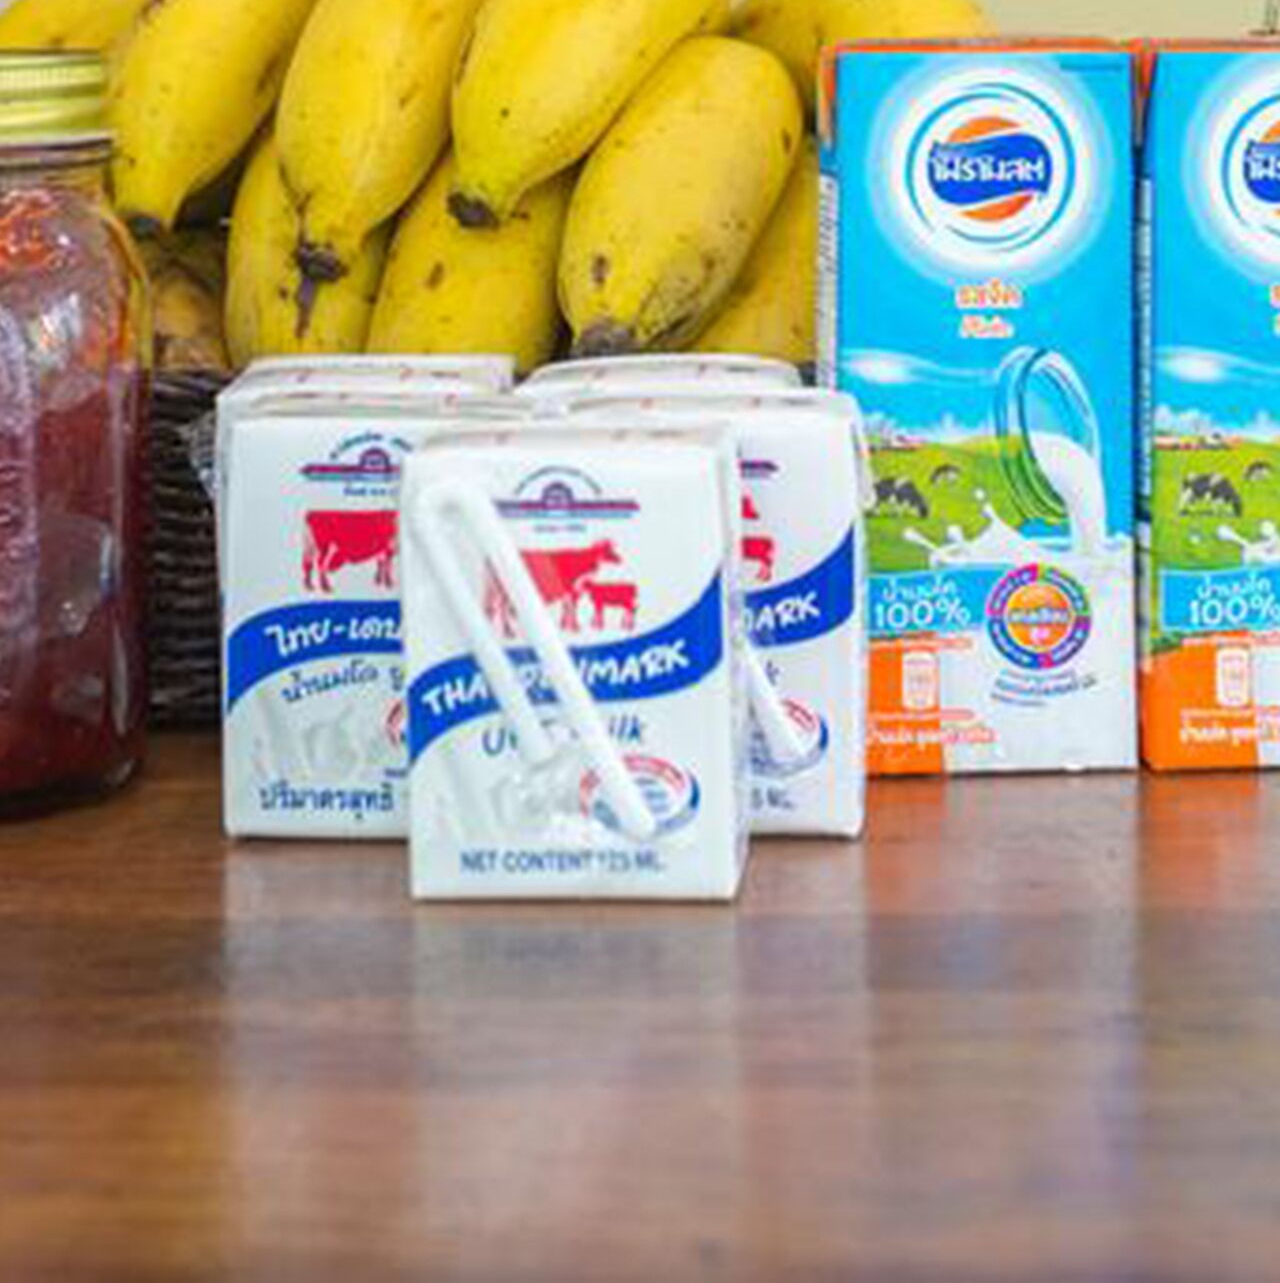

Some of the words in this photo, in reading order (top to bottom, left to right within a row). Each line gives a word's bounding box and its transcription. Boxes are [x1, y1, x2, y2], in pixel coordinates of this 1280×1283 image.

[875, 598, 972, 628] 100%
[263, 615, 401, 657] ไทย-เดน
[460, 848, 495, 872] NET
[501, 848, 593, 873] CONTENT
